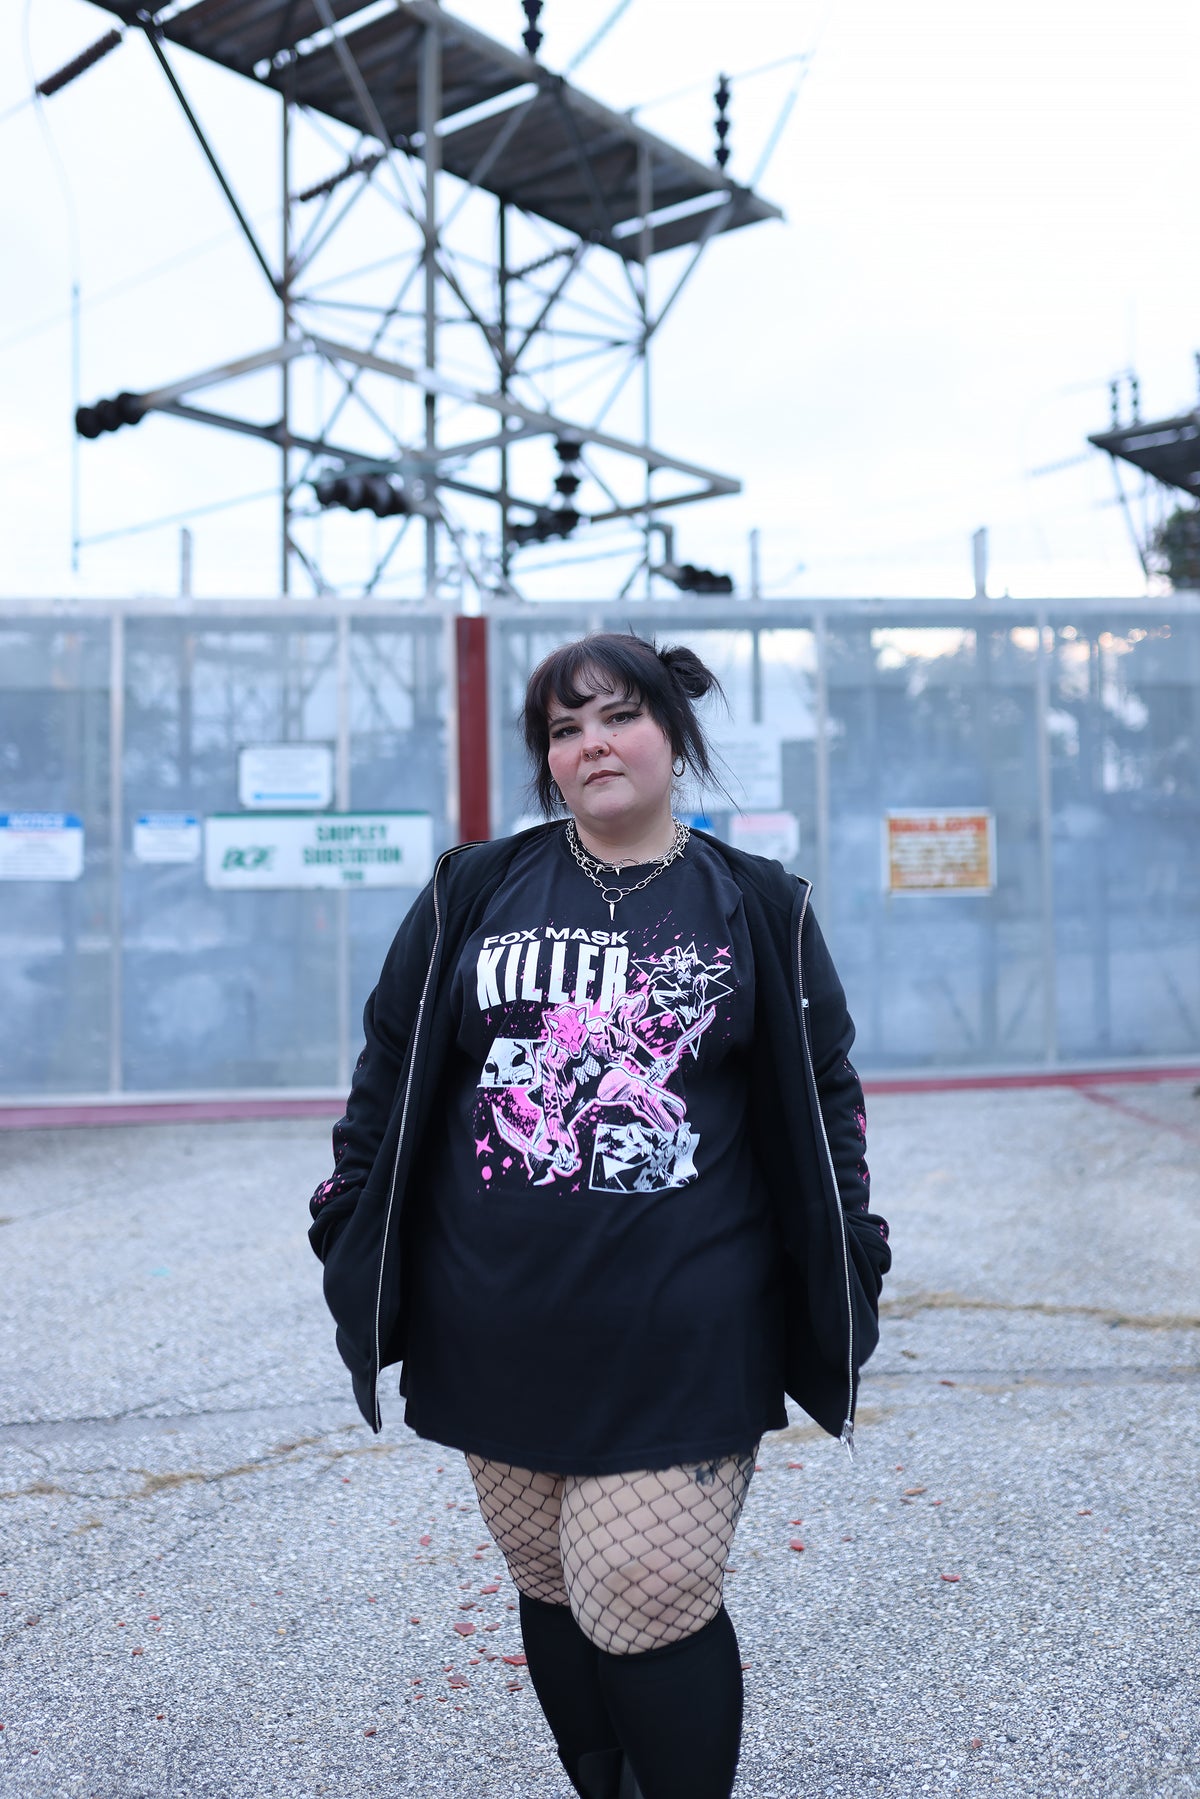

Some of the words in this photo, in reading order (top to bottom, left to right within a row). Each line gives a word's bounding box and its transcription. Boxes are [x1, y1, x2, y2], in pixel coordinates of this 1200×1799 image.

[303, 848, 404, 866] SUBSTATION
[483, 927, 539, 949] FOX
[545, 926, 629, 946] MASK
[476, 940, 630, 1012] KILLER
